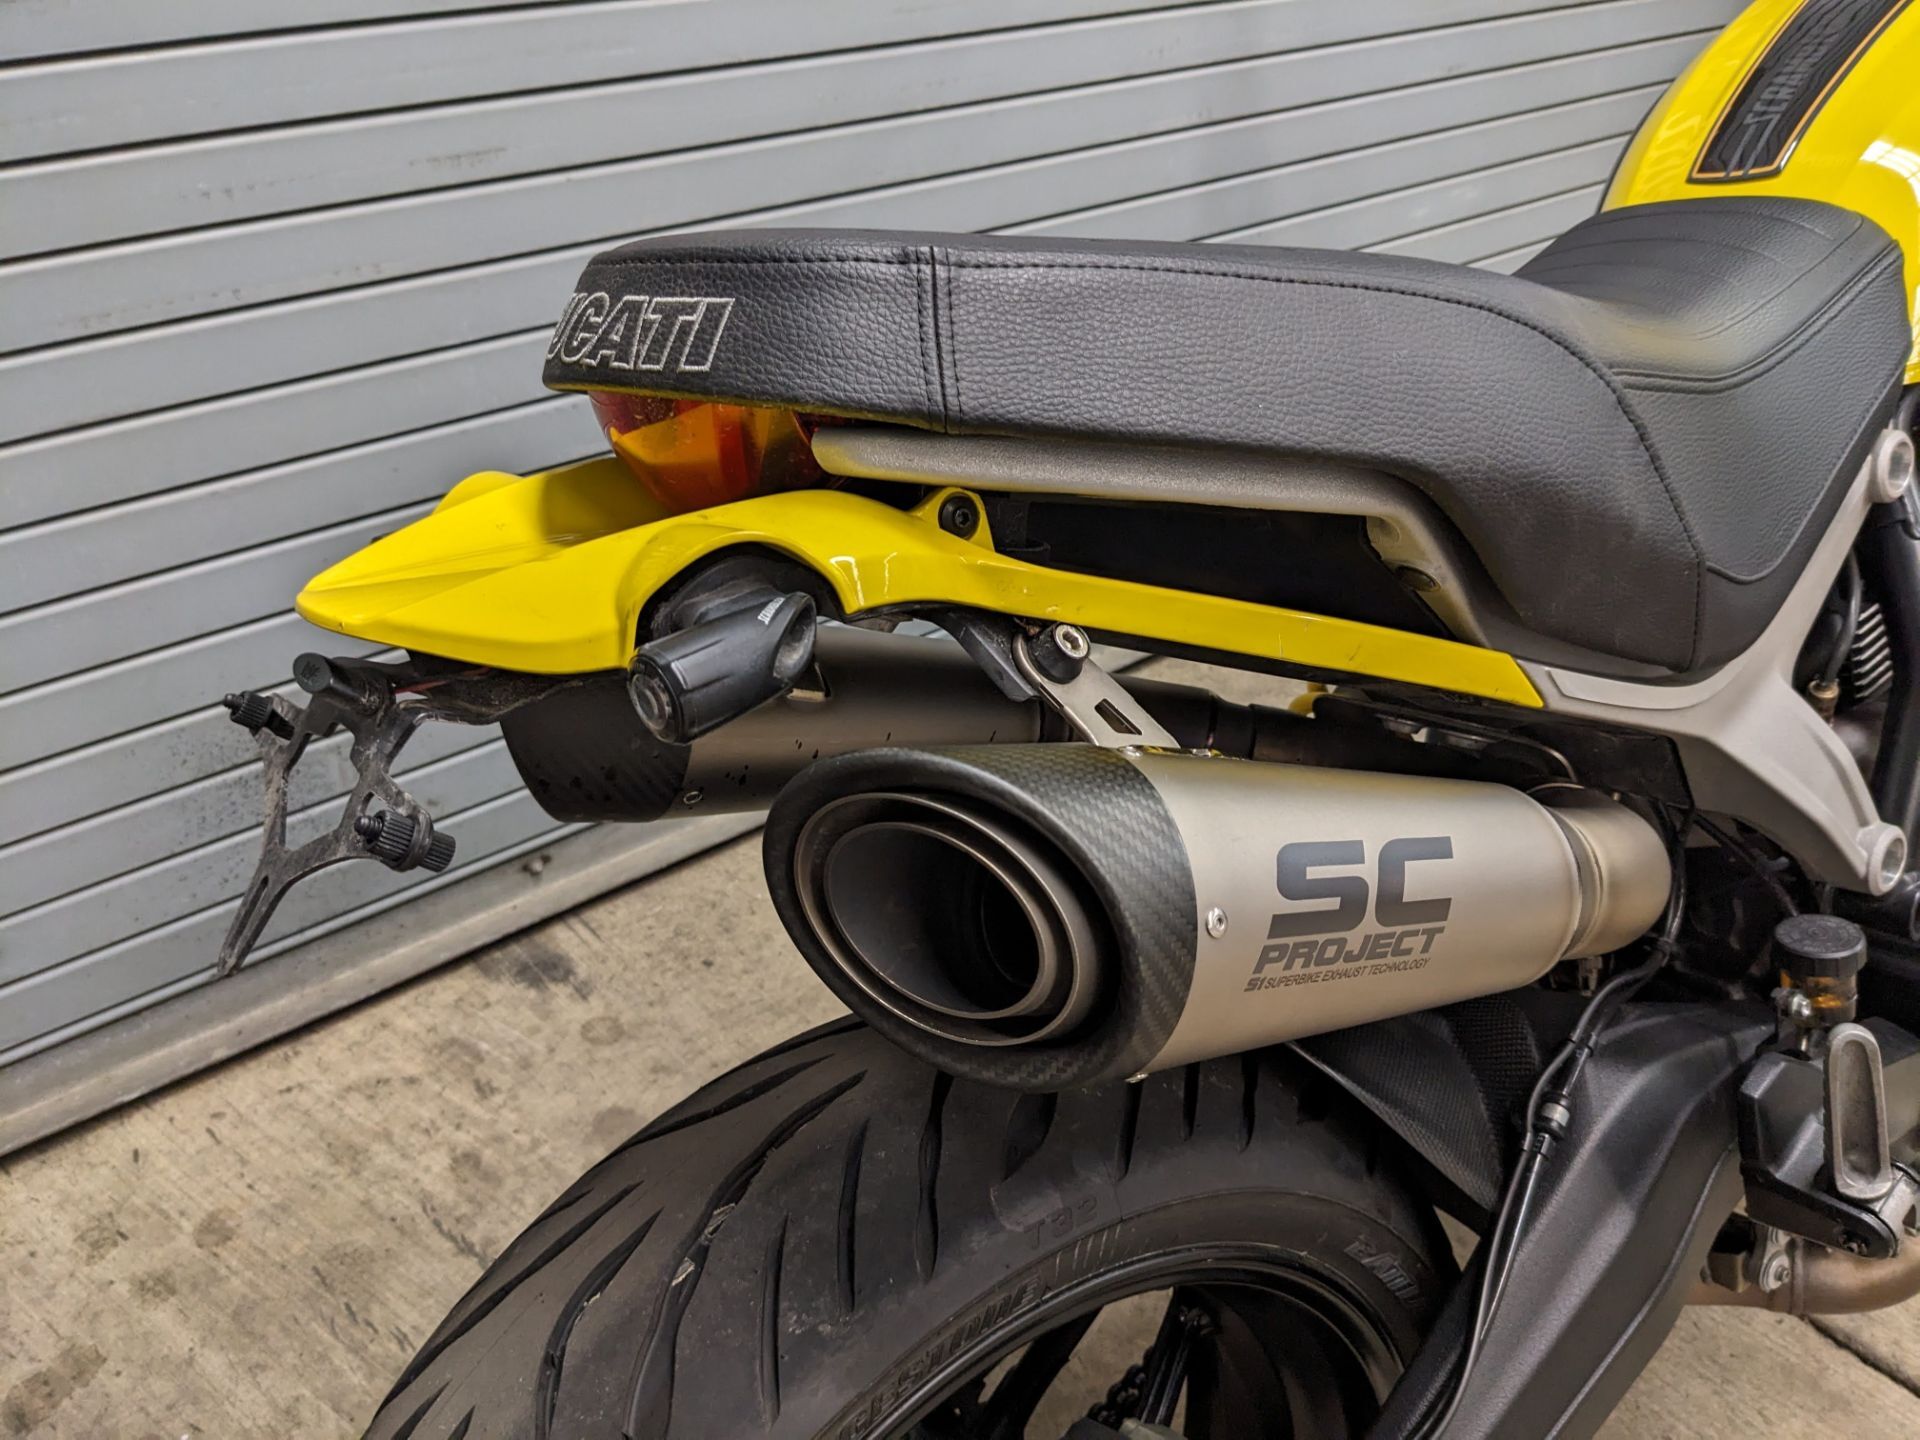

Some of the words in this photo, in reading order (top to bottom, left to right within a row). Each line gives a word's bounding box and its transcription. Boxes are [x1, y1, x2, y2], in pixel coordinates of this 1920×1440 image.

[1267, 836, 1453, 940] SC
[1243, 976, 1265, 992] S1
[1264, 971, 1322, 990] SUPERBIKE
[1322, 965, 1367, 982] EXHAUST
[1368, 957, 1431, 976] TECHNOLOGY
[1252, 926, 1445, 975] PROJECT
